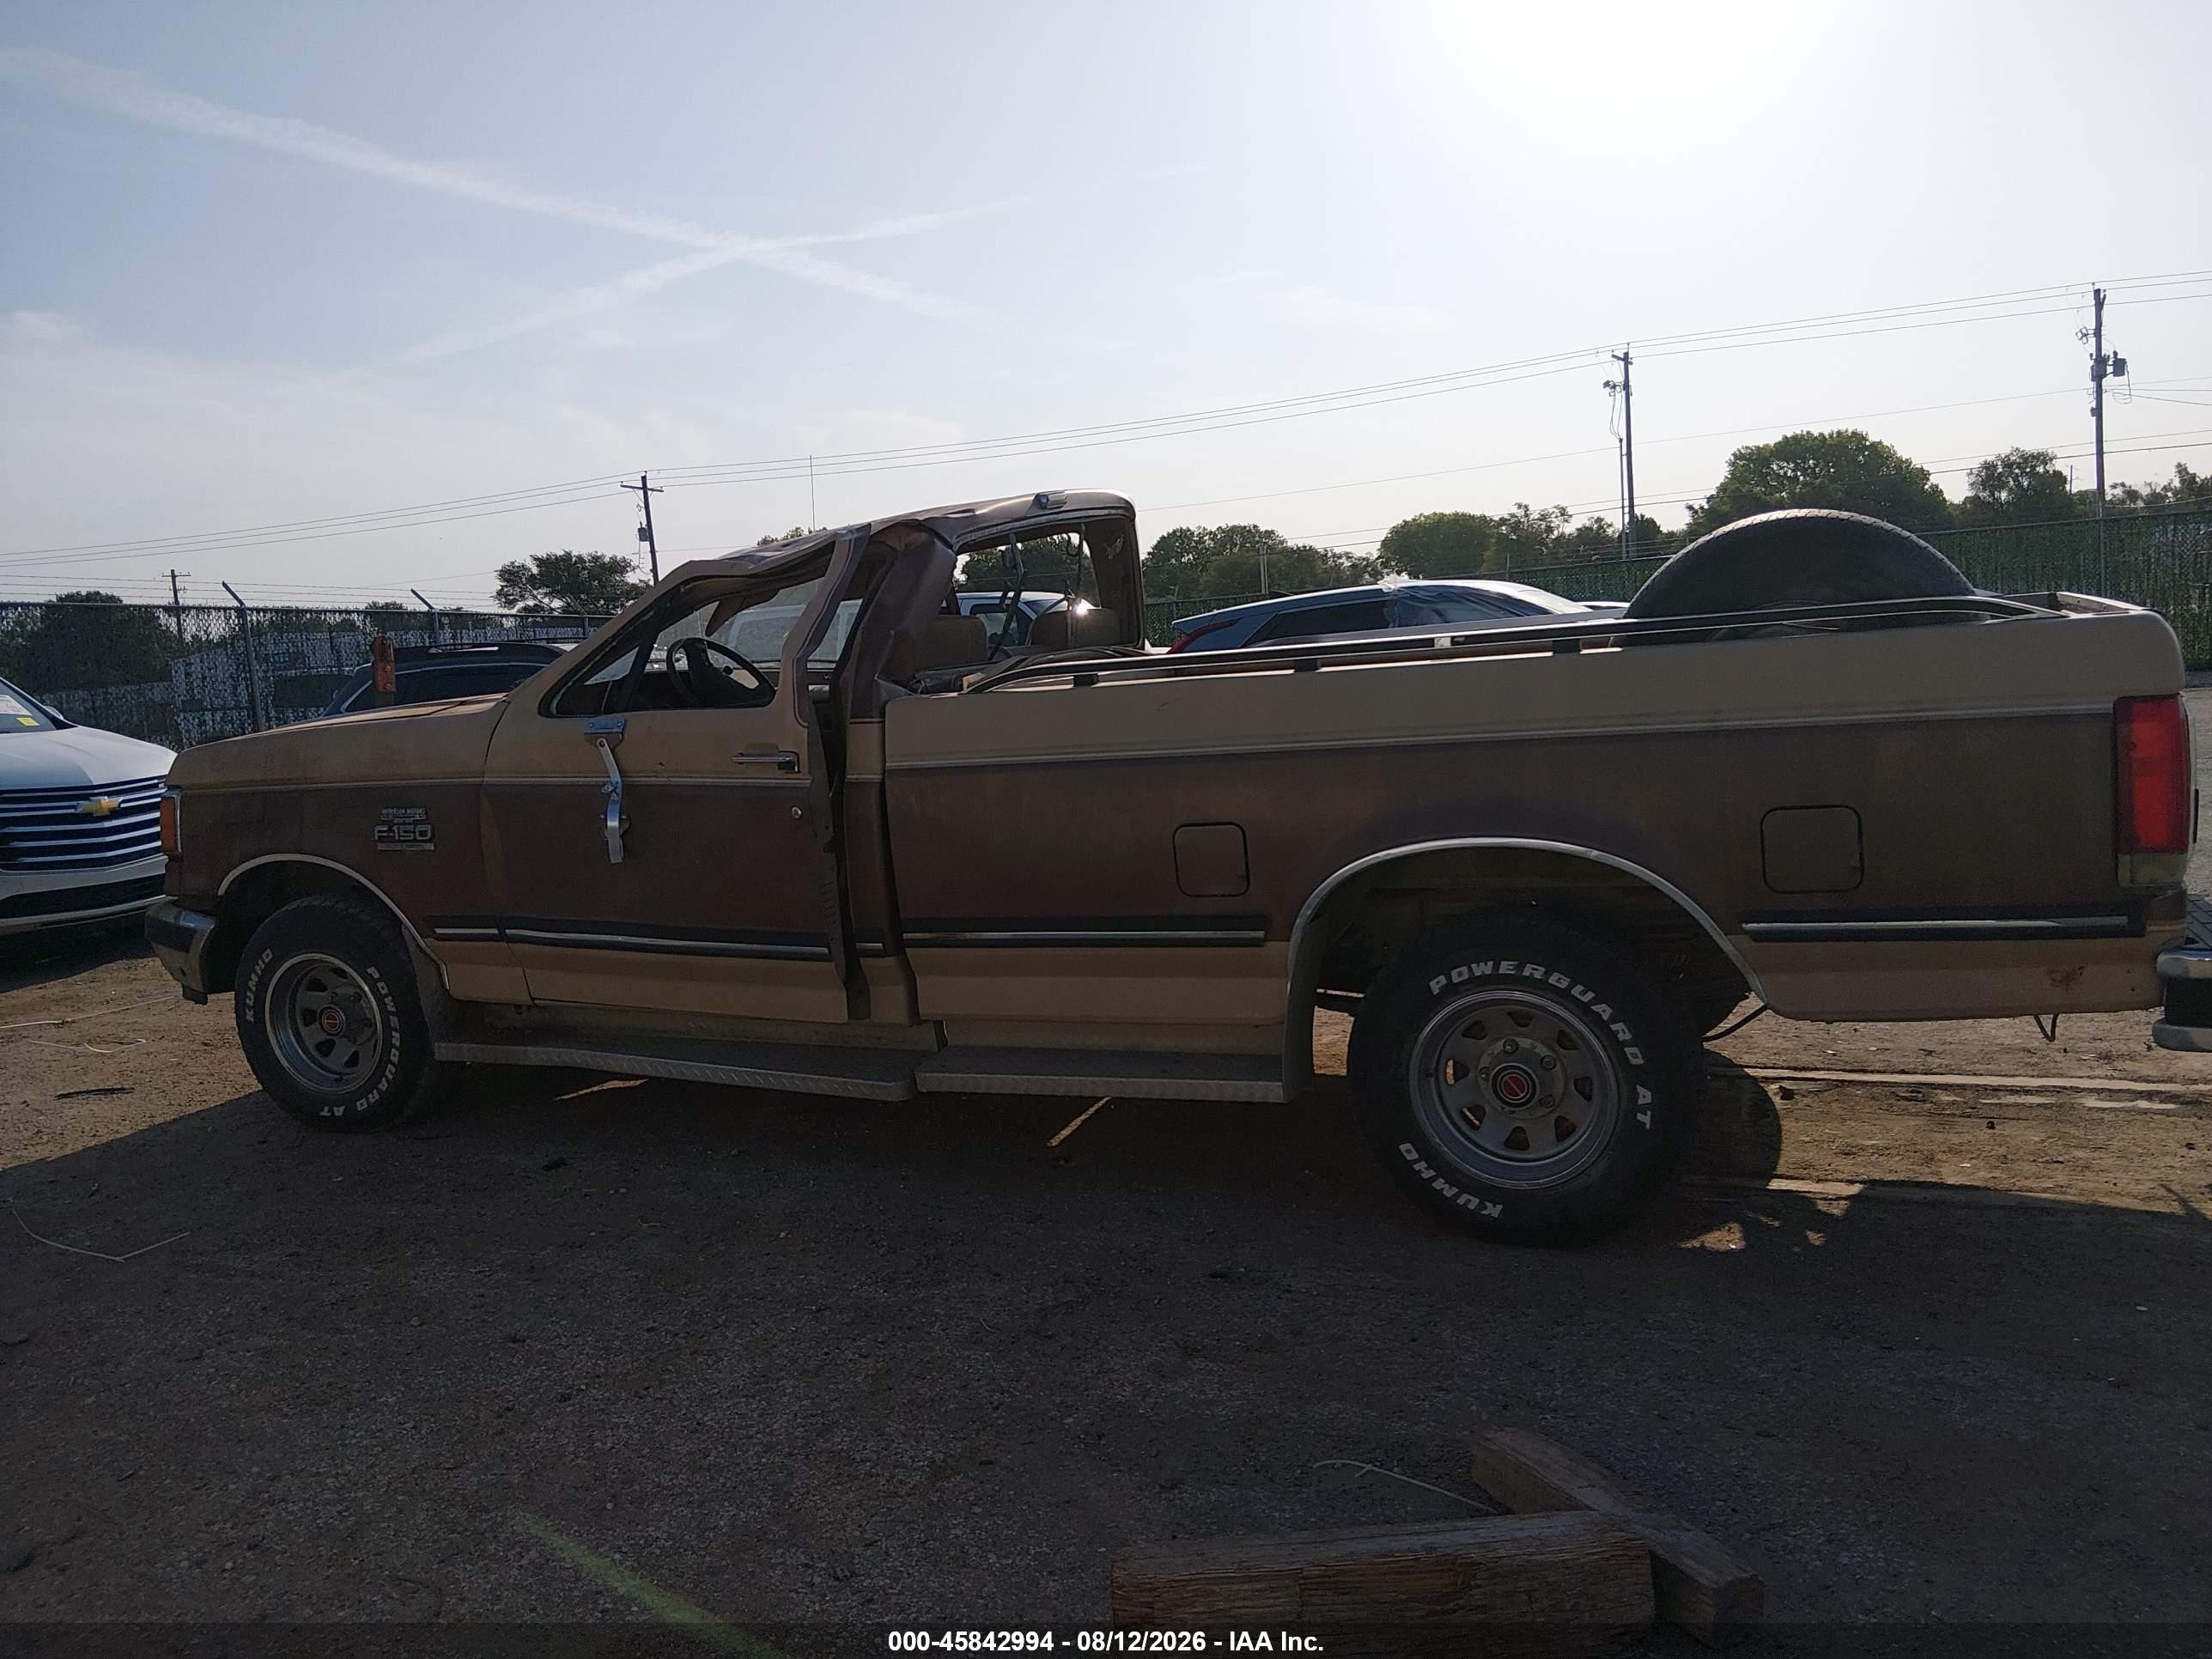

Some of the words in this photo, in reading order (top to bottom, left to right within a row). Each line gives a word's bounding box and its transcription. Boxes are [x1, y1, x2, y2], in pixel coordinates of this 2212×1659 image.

[374, 823, 432, 841] F-150
[244, 947, 274, 1023] KUMHO
[355, 965, 402, 1112] POWERGUARD
[1428, 959, 1644, 1066] POWERGUARD
[1635, 1084, 1653, 1130] AT
[319, 1104, 345, 1117] AT
[1398, 1141, 1504, 1218] KUMHO
